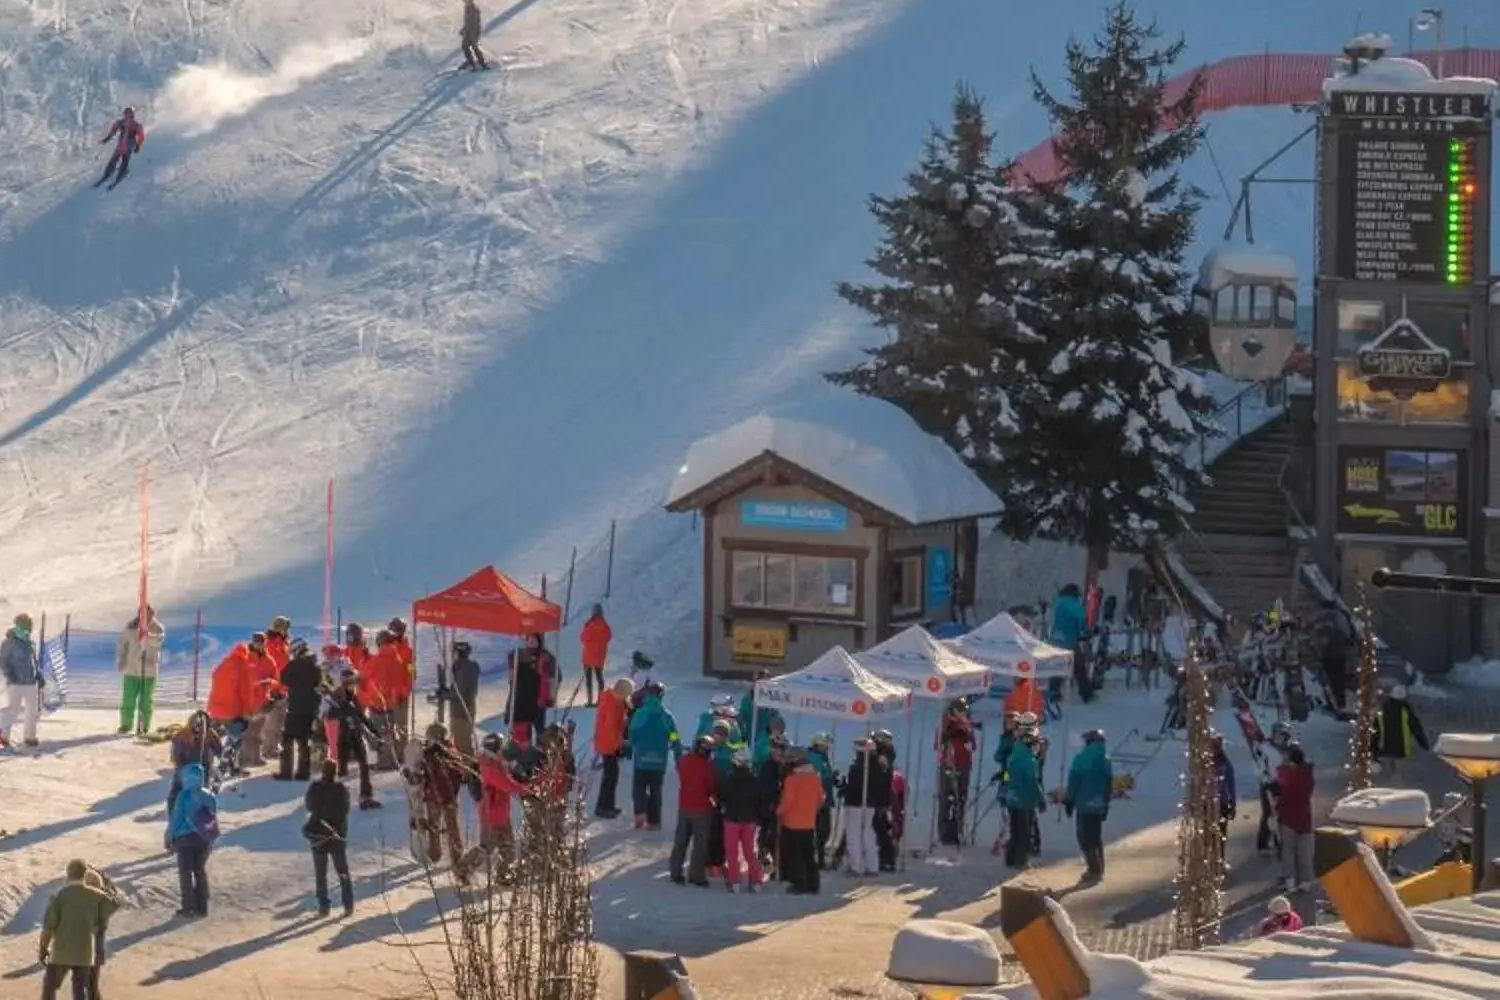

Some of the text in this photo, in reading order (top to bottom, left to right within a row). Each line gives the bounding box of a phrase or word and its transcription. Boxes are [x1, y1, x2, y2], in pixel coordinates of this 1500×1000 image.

[1343, 95, 1472, 113] WHISTLER
[1361, 120, 1454, 132] MOUNTAIN
[1424, 503, 1457, 530] GLC
